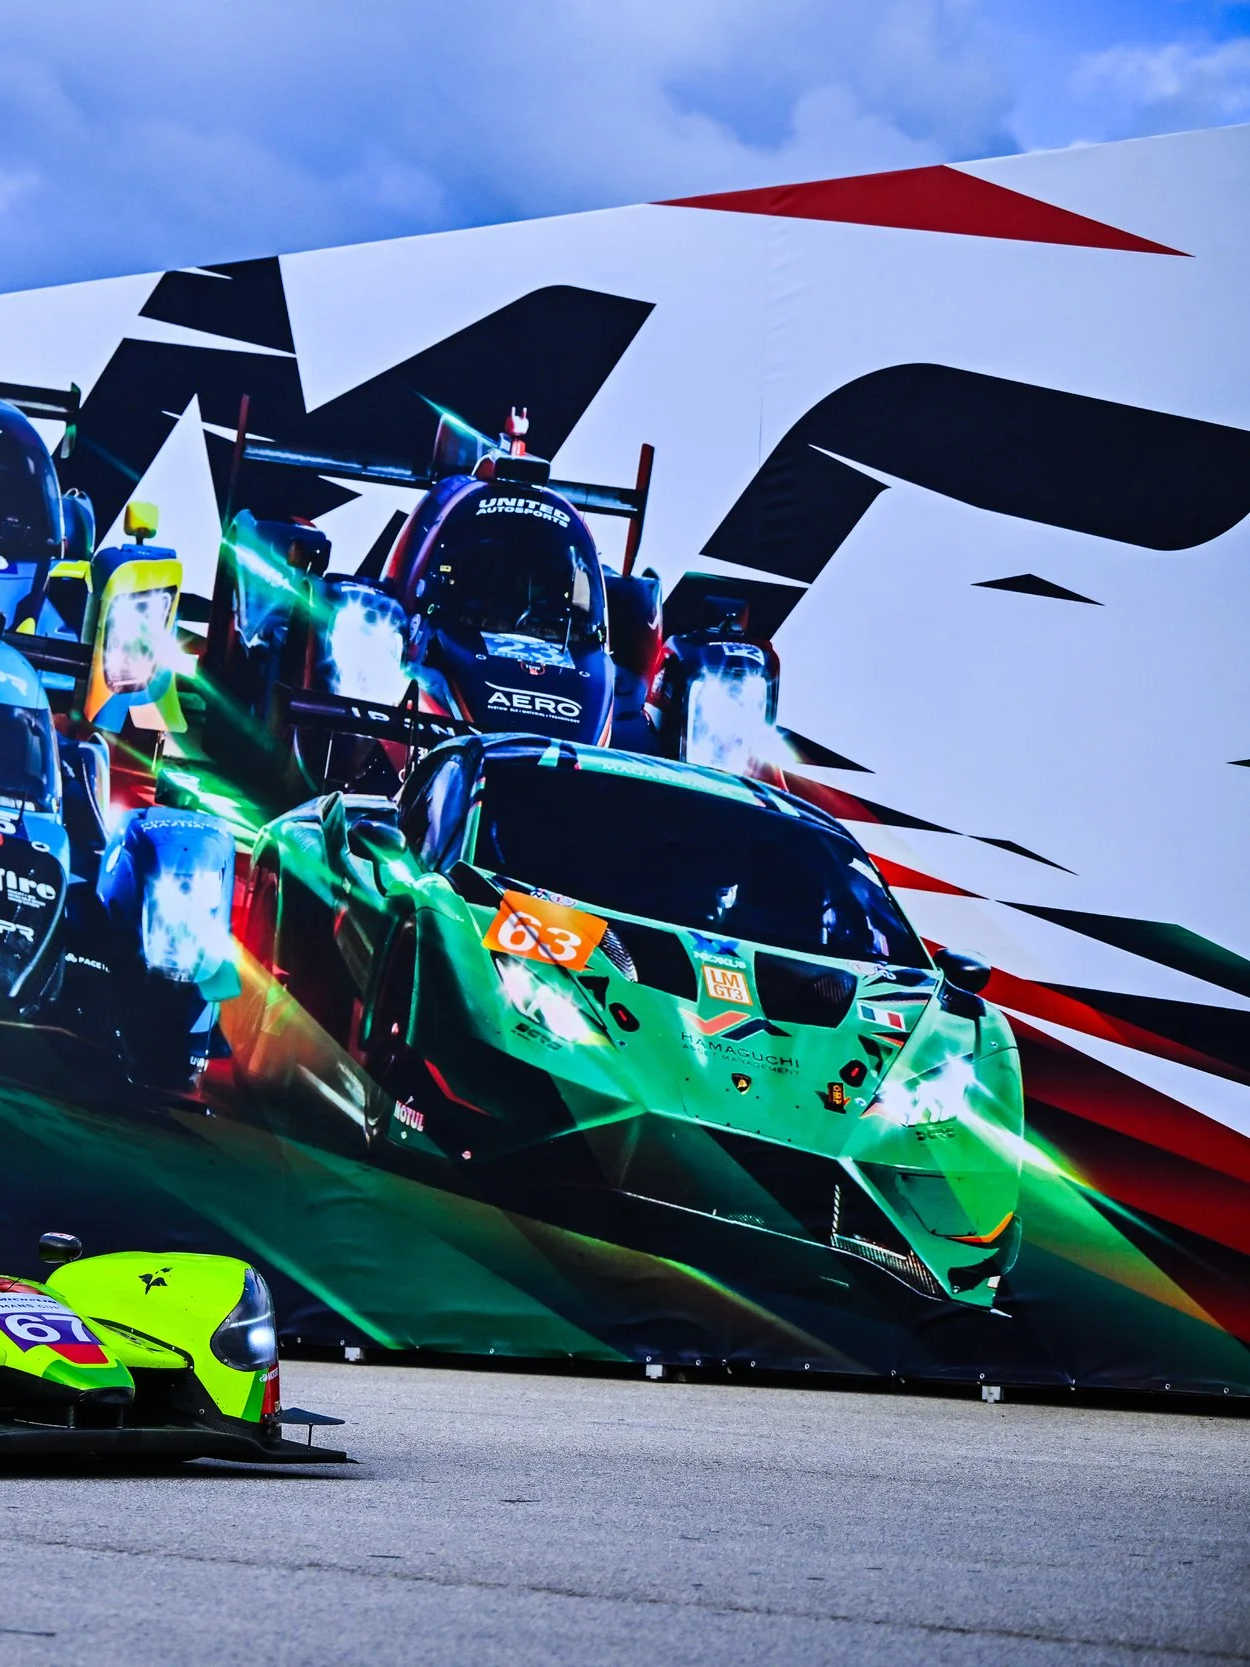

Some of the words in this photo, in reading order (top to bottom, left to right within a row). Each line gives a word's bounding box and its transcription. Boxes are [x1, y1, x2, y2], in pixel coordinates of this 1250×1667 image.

[475, 506, 569, 528] AUTOSPORTS
[478, 497, 571, 522] UNITED
[488, 691, 580, 718] AERO
[497, 911, 582, 962] 63
[710, 968, 741, 989] LM
[713, 984, 744, 1001] GT3
[681, 1031, 800, 1068] HAMAGUCHI
[393, 1099, 424, 1132] MOTUL
[5, 1314, 92, 1343] 67
